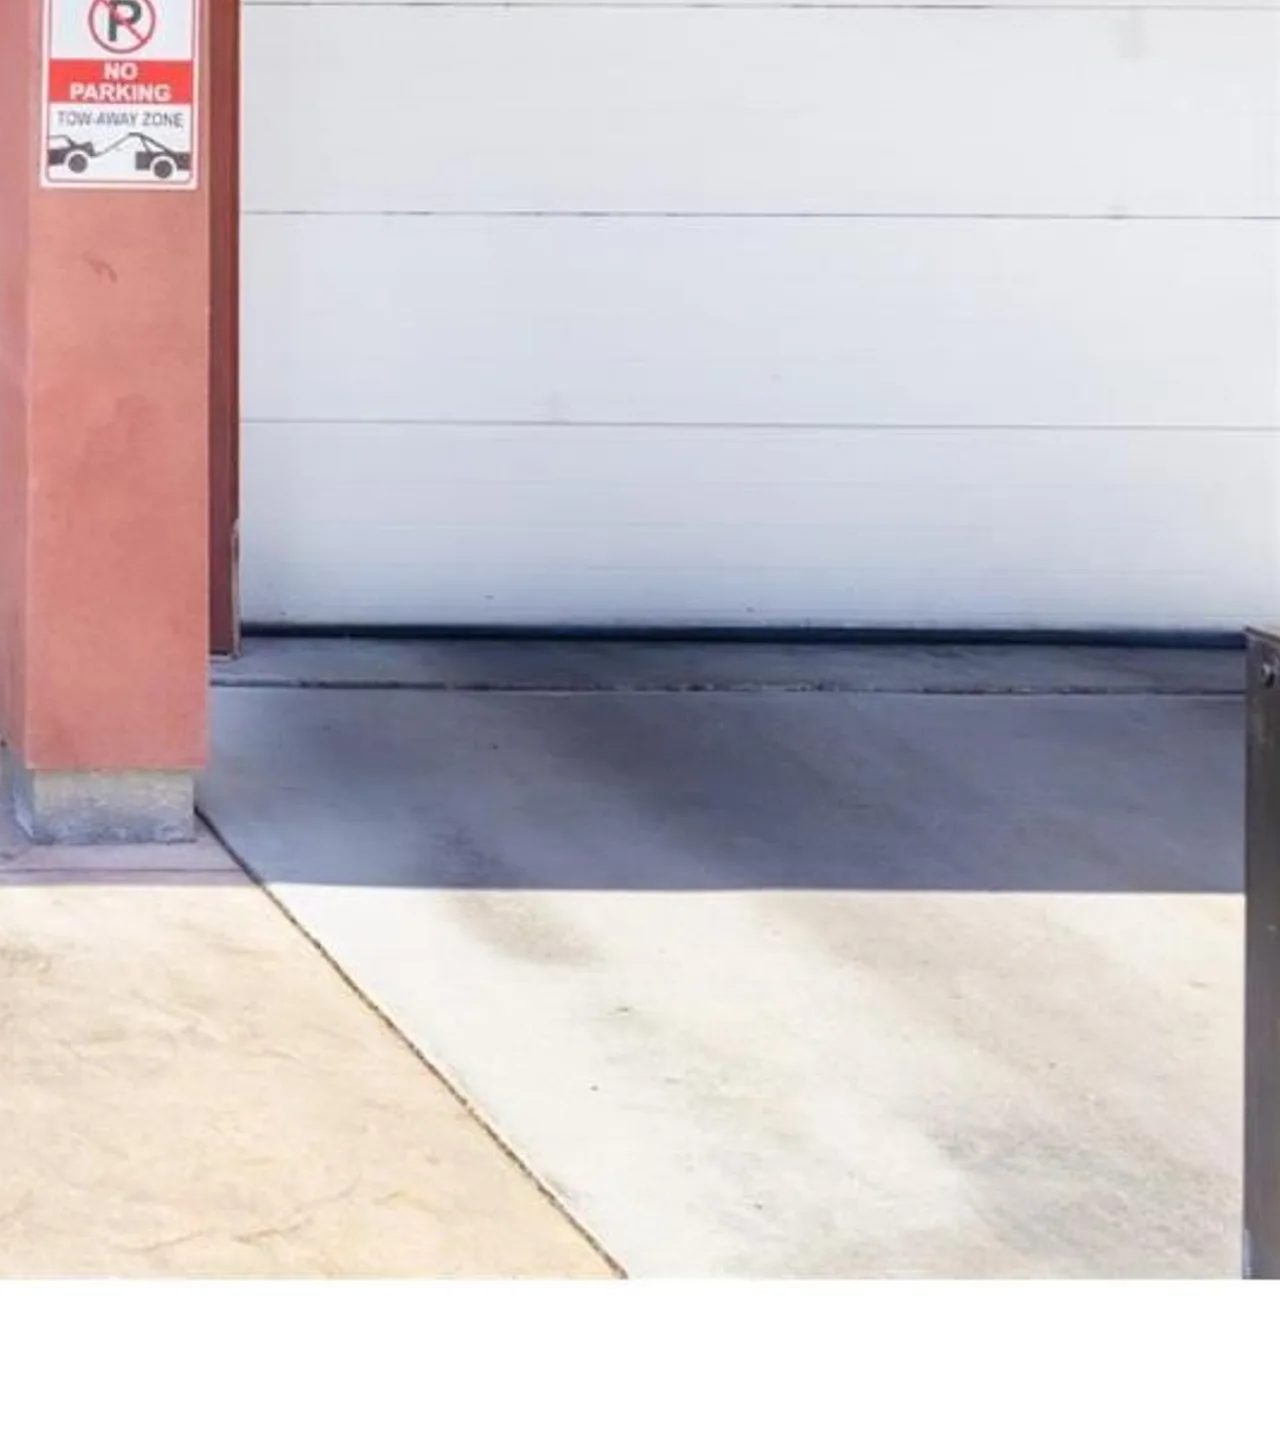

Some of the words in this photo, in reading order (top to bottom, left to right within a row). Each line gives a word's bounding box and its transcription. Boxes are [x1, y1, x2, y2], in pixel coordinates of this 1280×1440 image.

[103, 62, 139, 81] NO
[69, 82, 173, 102] PARKING
[58, 110, 138, 127] TOW-AWAY
[142, 111, 185, 129] ZONE
